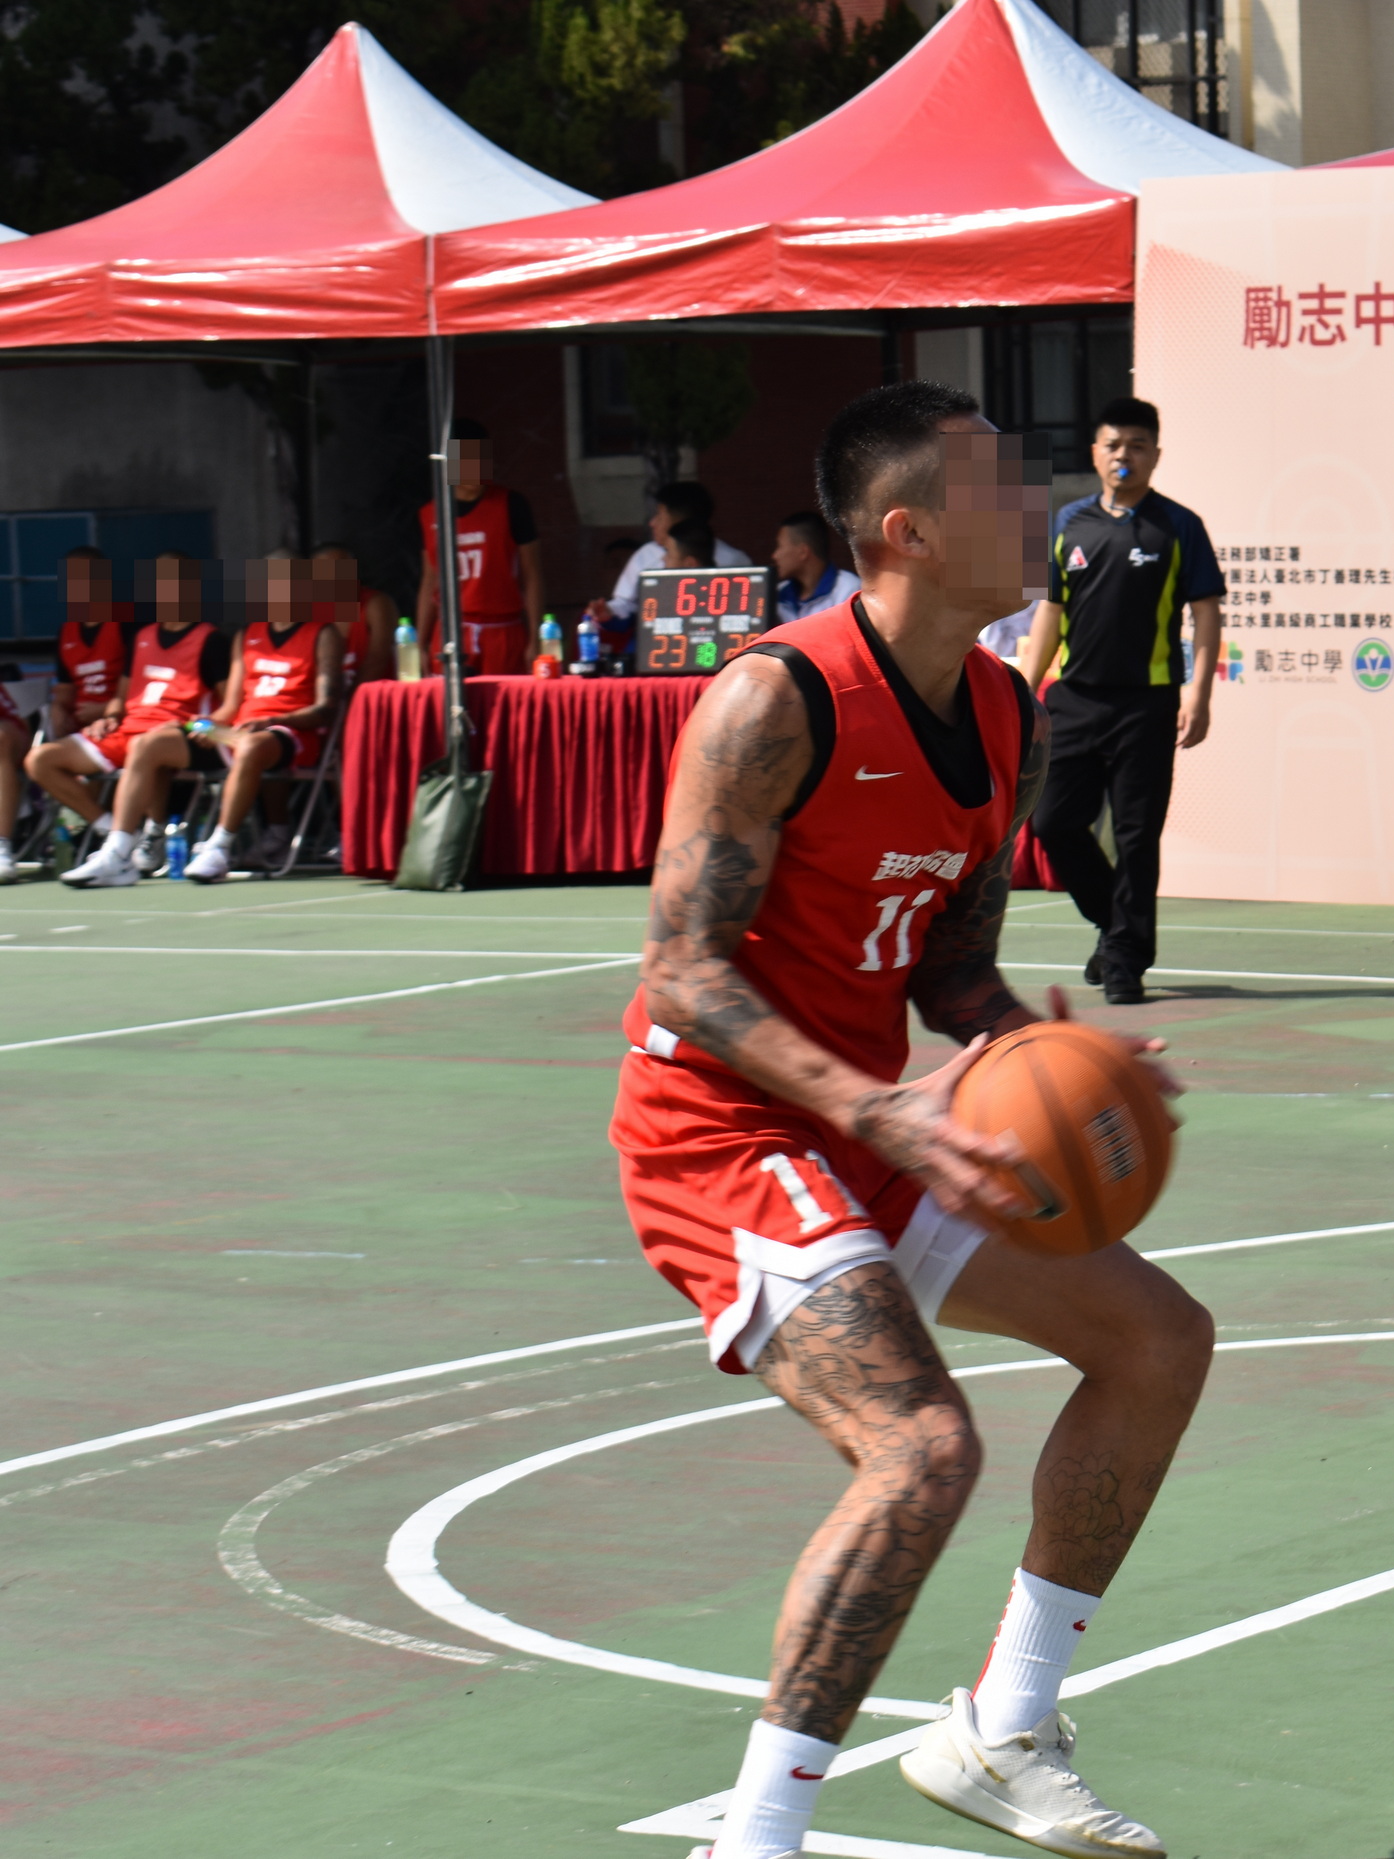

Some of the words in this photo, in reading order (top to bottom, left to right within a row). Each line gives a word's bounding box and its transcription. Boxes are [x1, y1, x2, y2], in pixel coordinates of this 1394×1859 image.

[675, 576, 751, 617] 6:07
[648, 635, 689, 669] 23
[723, 633, 763, 662] 2
[1254, 648, 1343, 673] 勵志中學
[856, 888, 937, 971] 11
